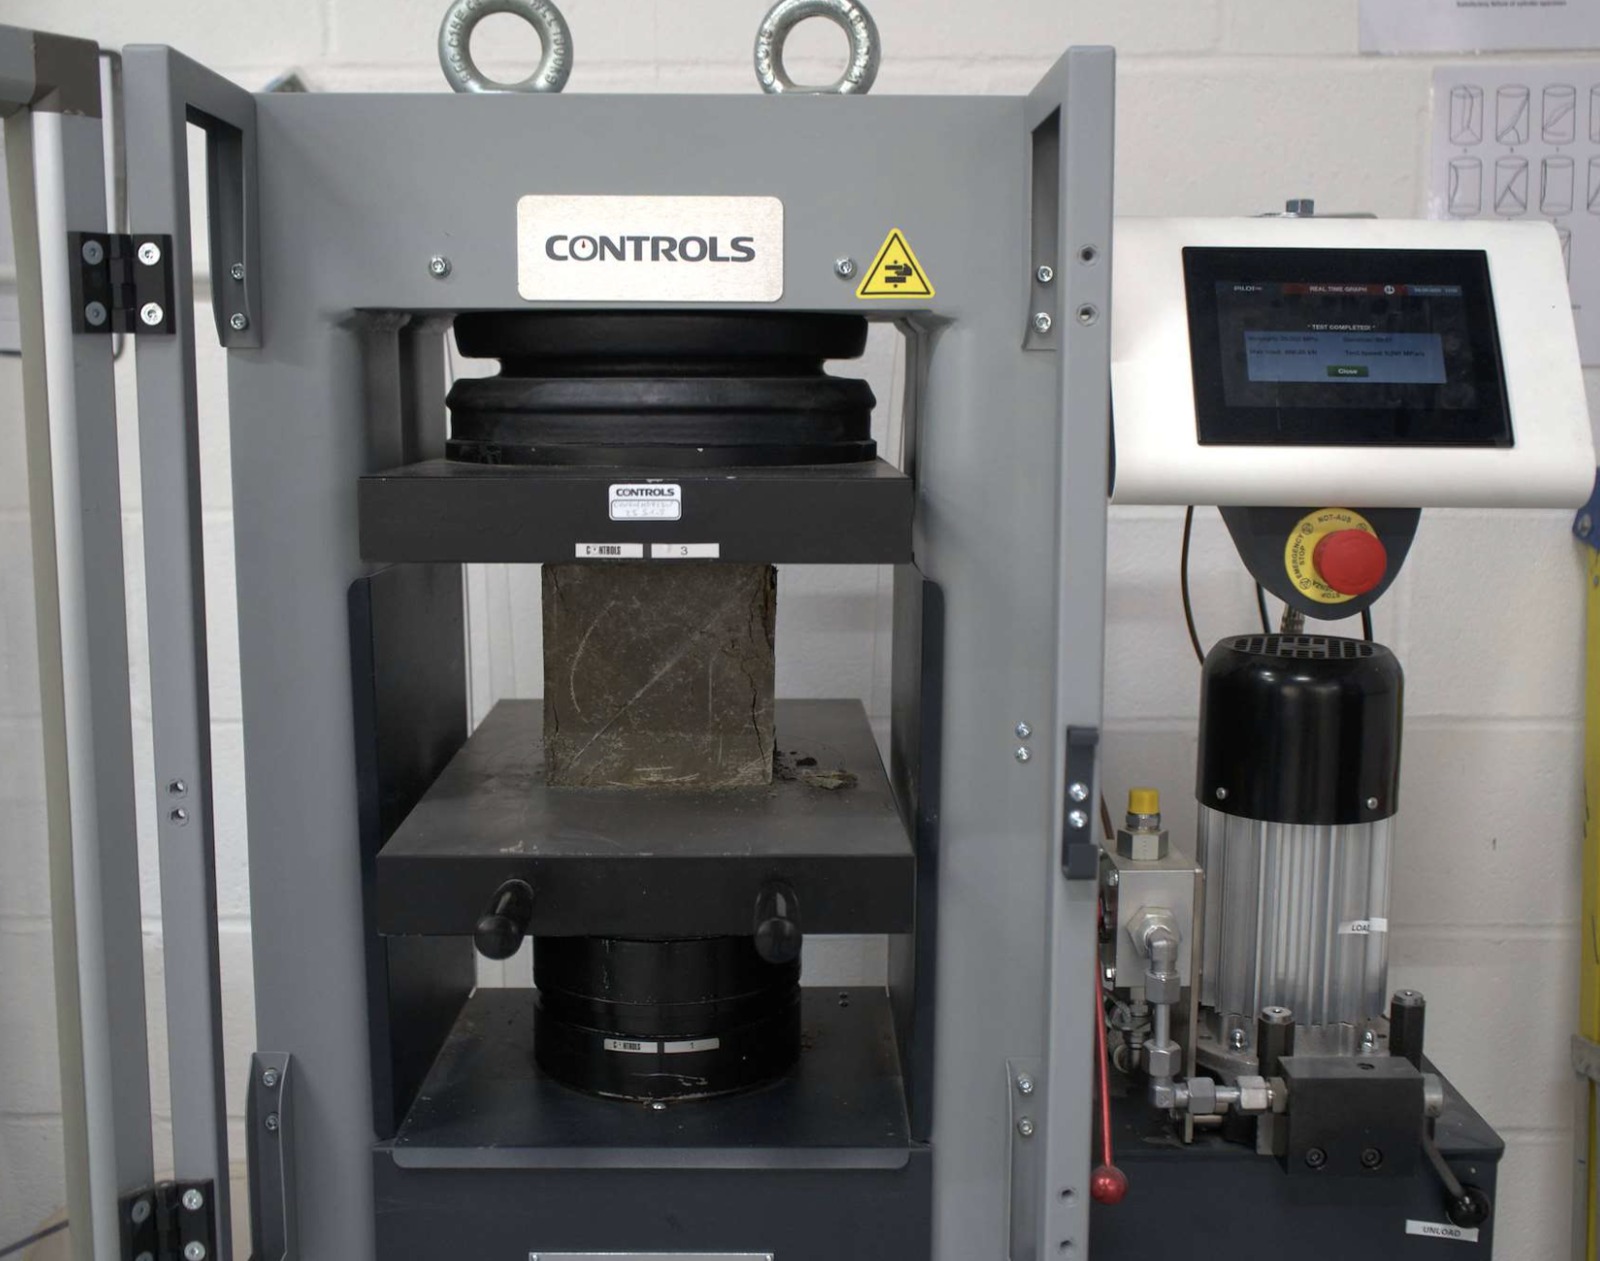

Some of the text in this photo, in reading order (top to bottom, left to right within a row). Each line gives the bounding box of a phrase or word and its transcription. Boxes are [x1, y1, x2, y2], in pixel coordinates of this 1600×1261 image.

[545, 235, 756, 262] CONTROLS
[616, 488, 675, 497] CONTROLS
[1317, 514, 1352, 524] NOT-AUS
[586, 545, 622, 556] CNTROLS
[680, 546, 689, 556] 3
[1298, 545, 1306, 565] STOP
[1291, 534, 1304, 579] EMERGENCY
[613, 1041, 641, 1050] CNTROLS
[1422, 1226, 1461, 1237] UNLOAD
